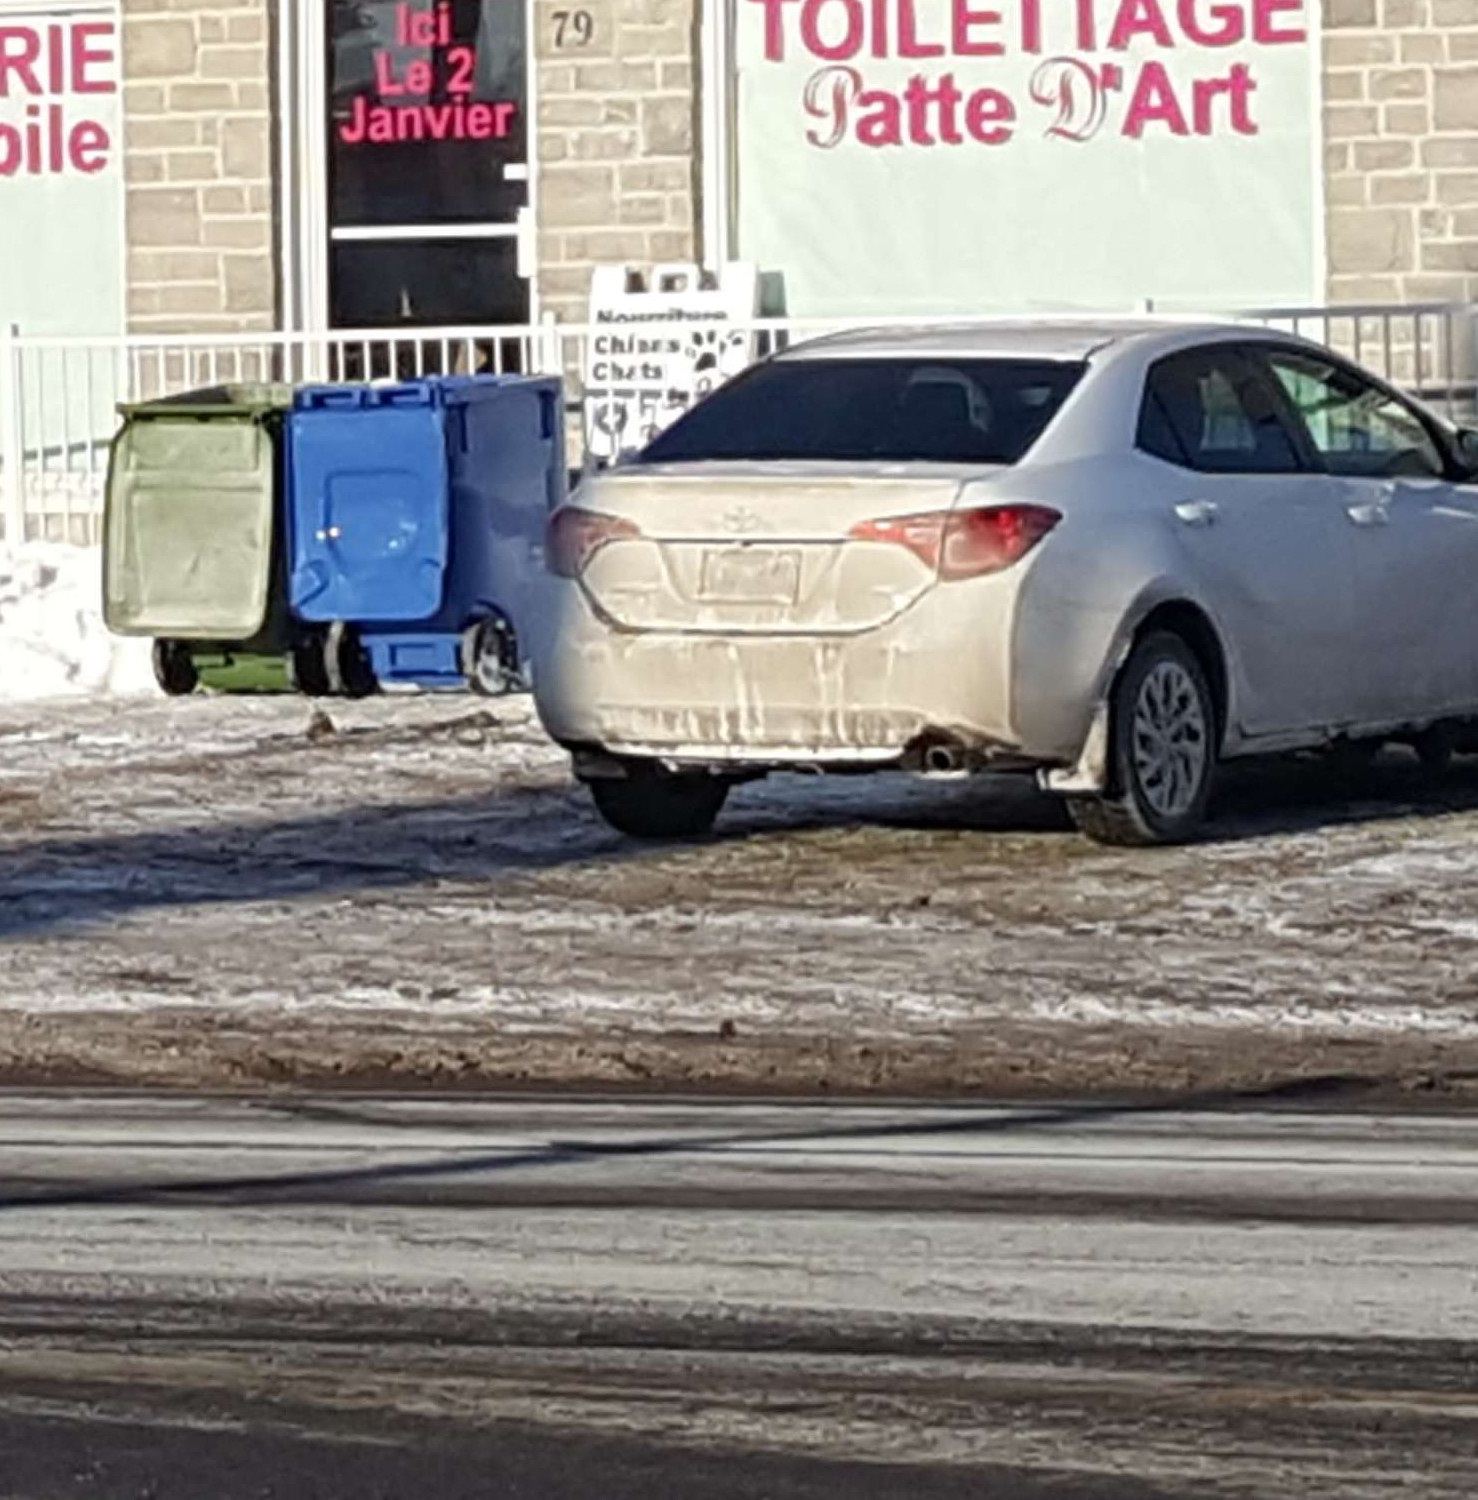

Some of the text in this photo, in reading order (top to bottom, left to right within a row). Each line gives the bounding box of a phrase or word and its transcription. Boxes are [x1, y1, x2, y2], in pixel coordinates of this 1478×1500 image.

[396, 0, 452, 47] Ici
[550, 10, 594, 48] 79
[373, 47, 475, 96] Le 2
[339, 94, 514, 142] Janvier
[803, 56, 1259, 149] Patte D'Art
